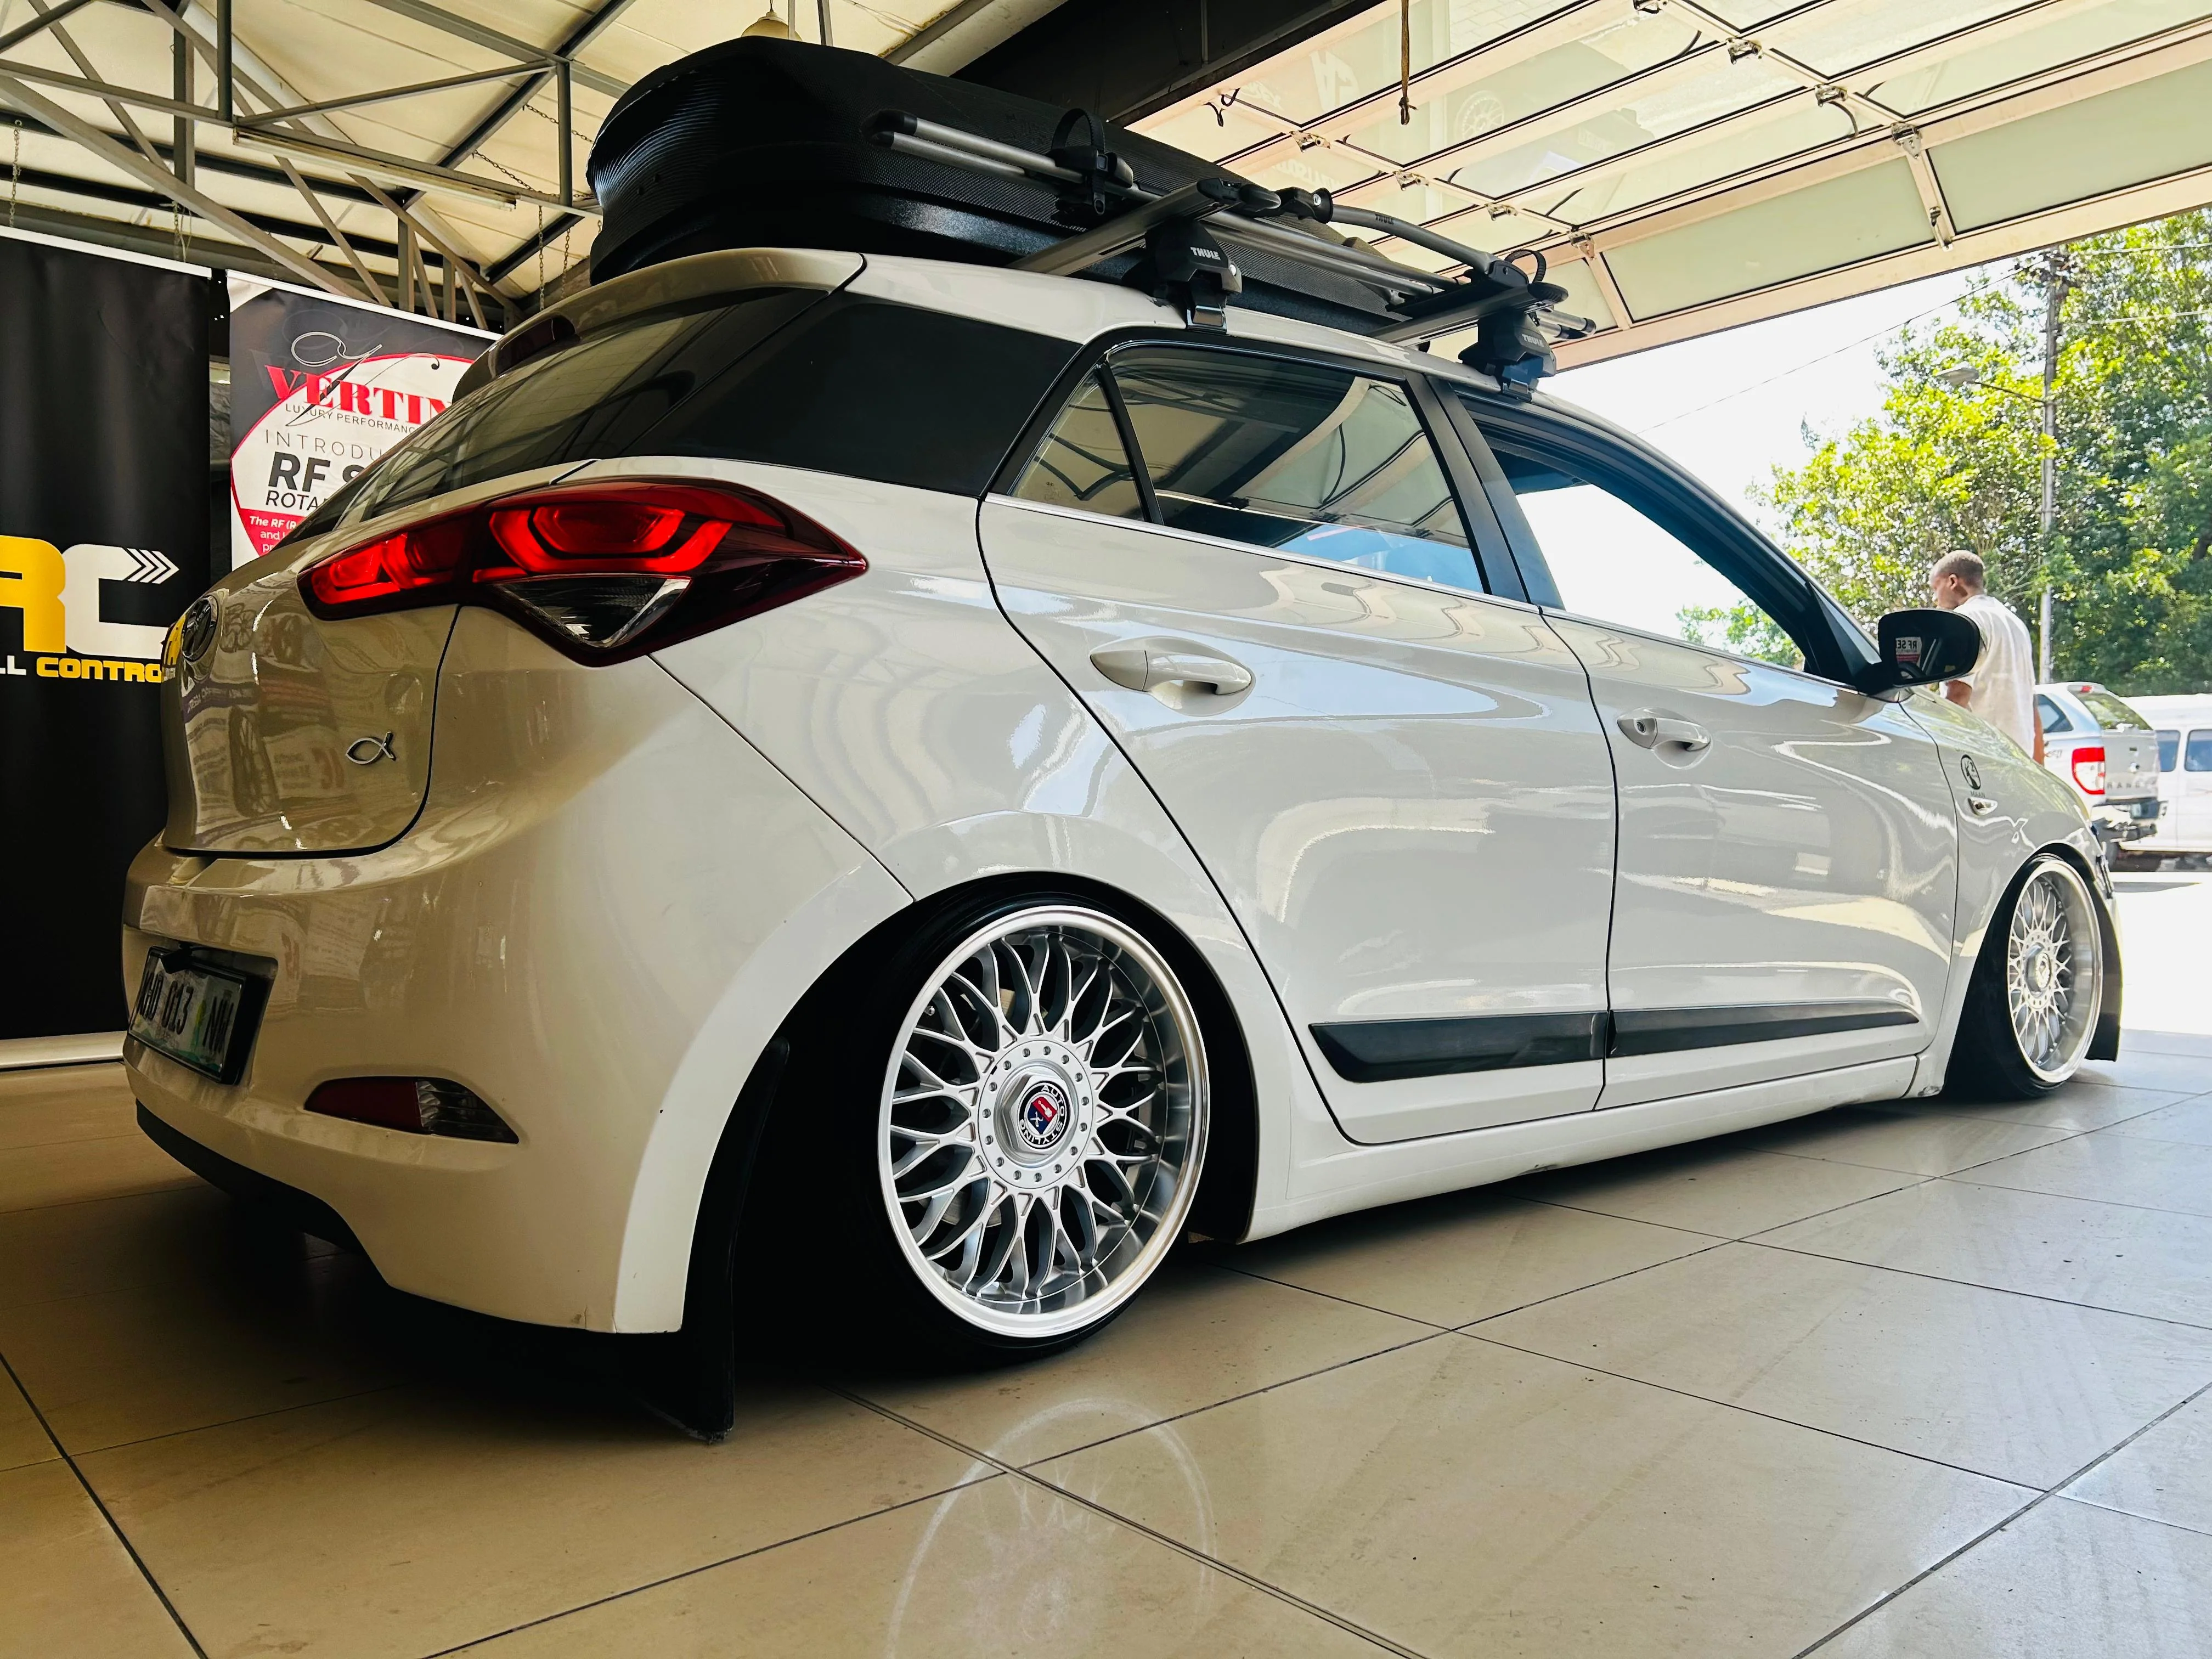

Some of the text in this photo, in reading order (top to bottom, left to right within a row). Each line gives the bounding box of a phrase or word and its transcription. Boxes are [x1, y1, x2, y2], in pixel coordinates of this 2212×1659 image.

[1190, 246, 1221, 261] THULE
[1521, 333, 1544, 347] THULE
[285, 403, 334, 420] LUXURY
[266, 429, 382, 461] INTRODU
[268, 452, 331, 493] RF
[266, 490, 328, 512] ROTA
[250, 516, 269, 527] The
[270, 518, 285, 529] RF
[260, 531, 280, 540] and
[161, 980, 194, 1035] 013
[202, 995, 234, 1053] NW
[1019, 1085, 1065, 1145] AUTO STYLING
